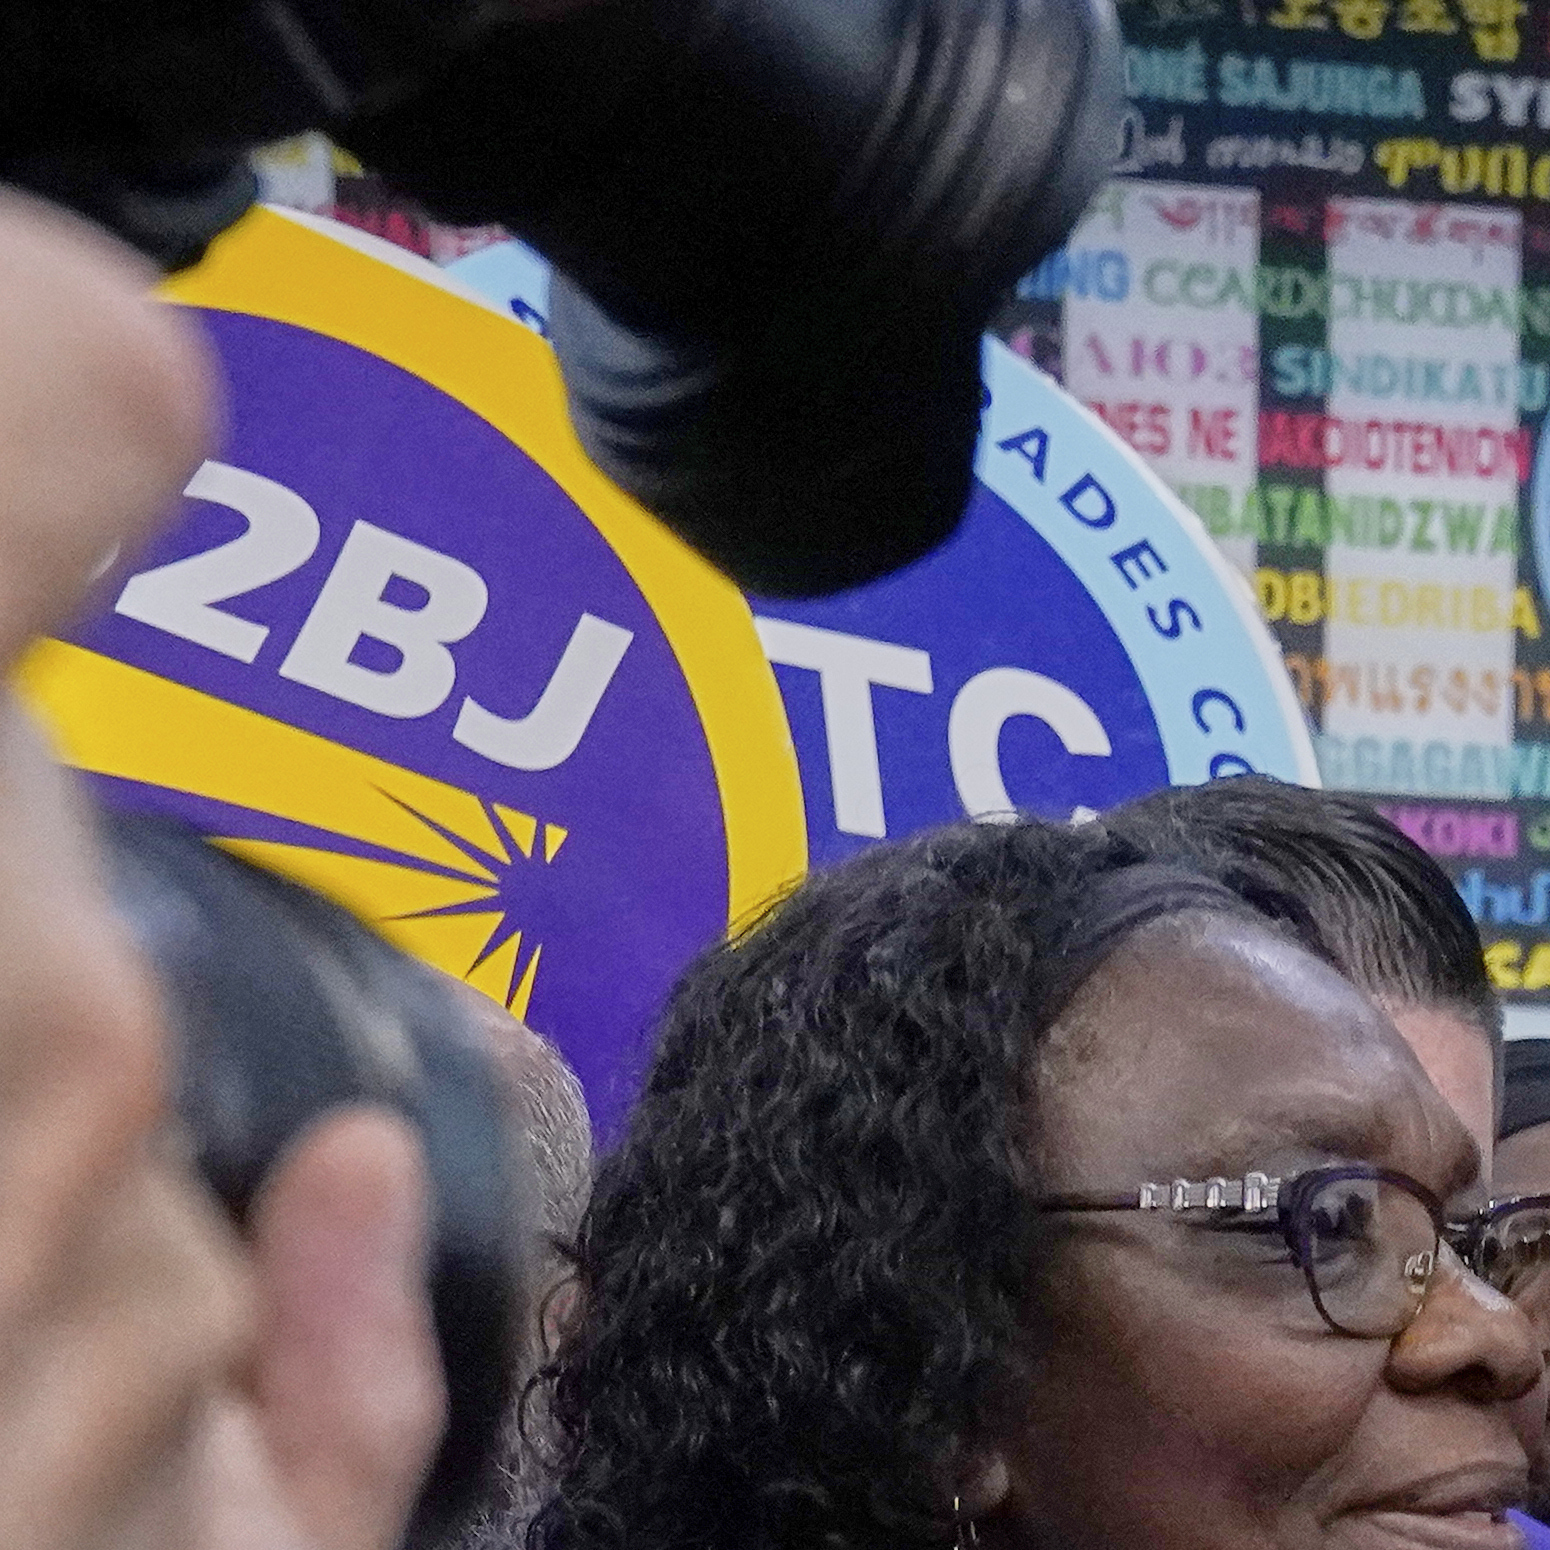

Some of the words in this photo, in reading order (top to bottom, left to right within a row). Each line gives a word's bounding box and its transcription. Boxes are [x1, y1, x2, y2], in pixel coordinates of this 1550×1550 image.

[114, 458, 635, 772] 2BJ
[996, 425, 1204, 642] ADES
[753, 614, 1113, 839] TC
